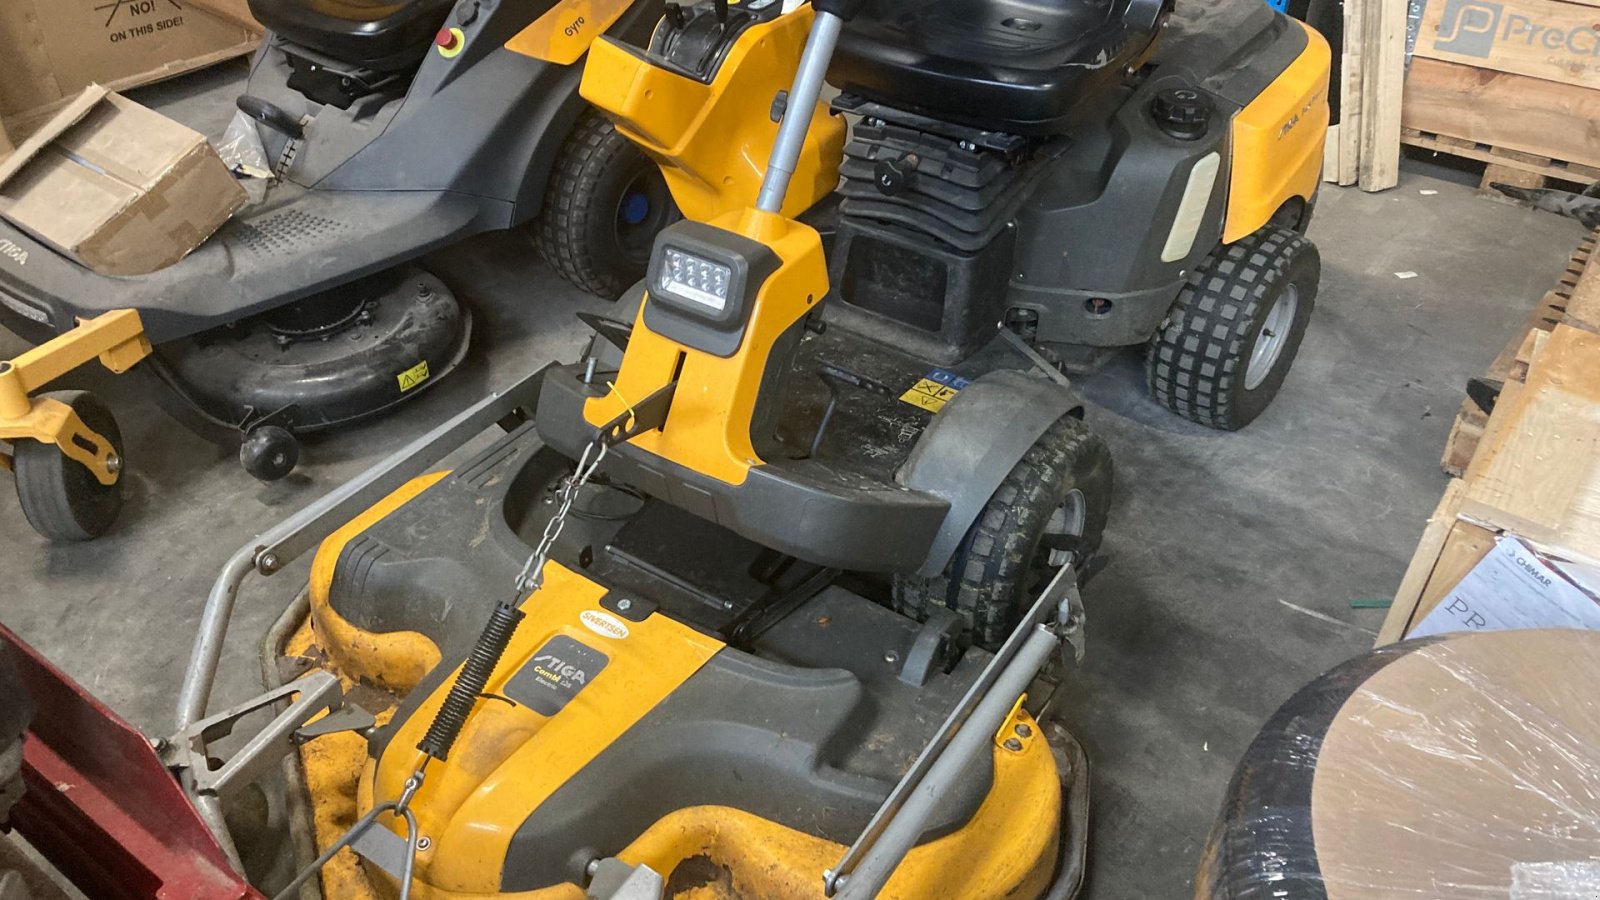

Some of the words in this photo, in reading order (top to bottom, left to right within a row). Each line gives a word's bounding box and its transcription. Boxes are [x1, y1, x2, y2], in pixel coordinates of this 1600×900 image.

[130, 0, 155, 16] NO!
[110, 31, 126, 42] ON
[128, 23, 154, 38] THIS
[156, 16, 183, 31] SIDE!
[564, 16, 585, 37] Gyro
[1516, 557, 1552, 587] CHIMAR
[582, 611, 627, 637] SIVERTSEN
[534, 655, 585, 685] STIGA
[534, 665, 562, 682] Combi
